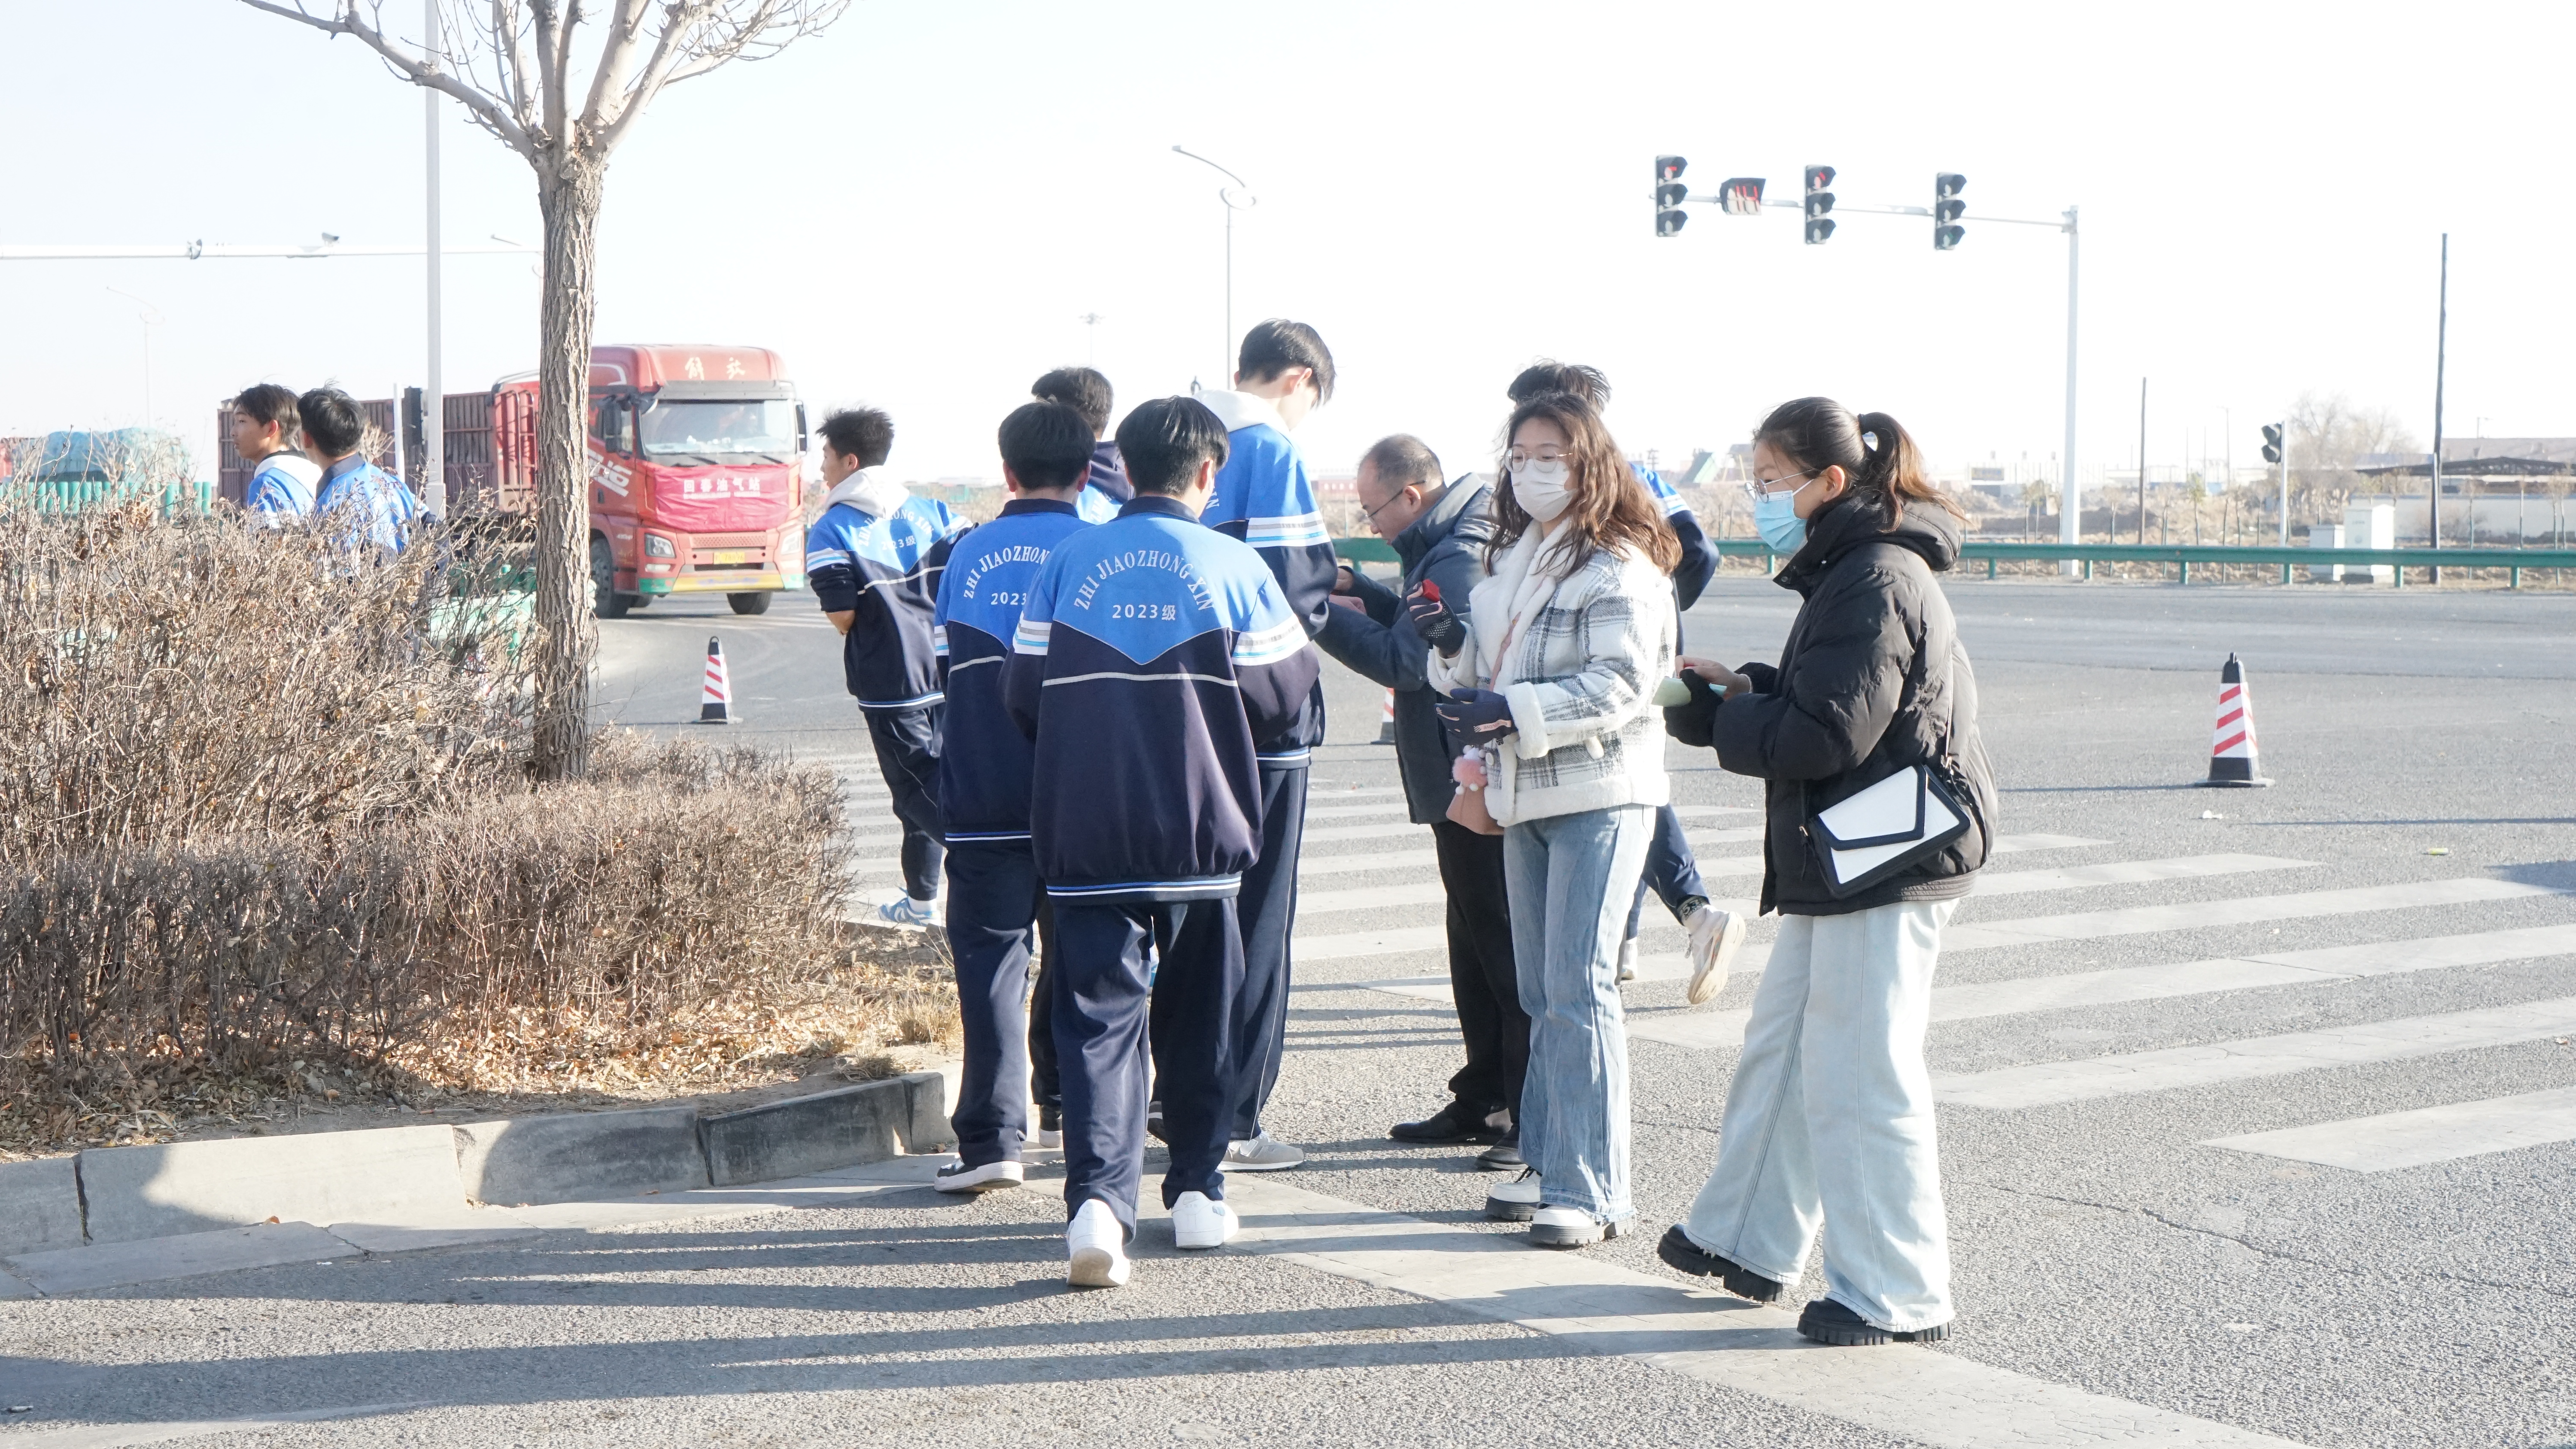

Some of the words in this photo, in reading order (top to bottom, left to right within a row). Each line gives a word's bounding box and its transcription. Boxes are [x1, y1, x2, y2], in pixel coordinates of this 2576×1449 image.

[1206, 485, 1220, 509] IN
[859, 526, 871, 547] ZHI
[915, 516, 934, 535] XIN
[963, 568, 981, 599] ZHI
[978, 546, 1050, 573] JIAOZHON
[1073, 575, 1100, 610] ZHI
[1096, 550, 1194, 580] JIAOZHONG
[1187, 576, 1215, 611] XIN
[990, 592, 1027, 606] 2023
[1112, 604, 1176, 621] 2023级
